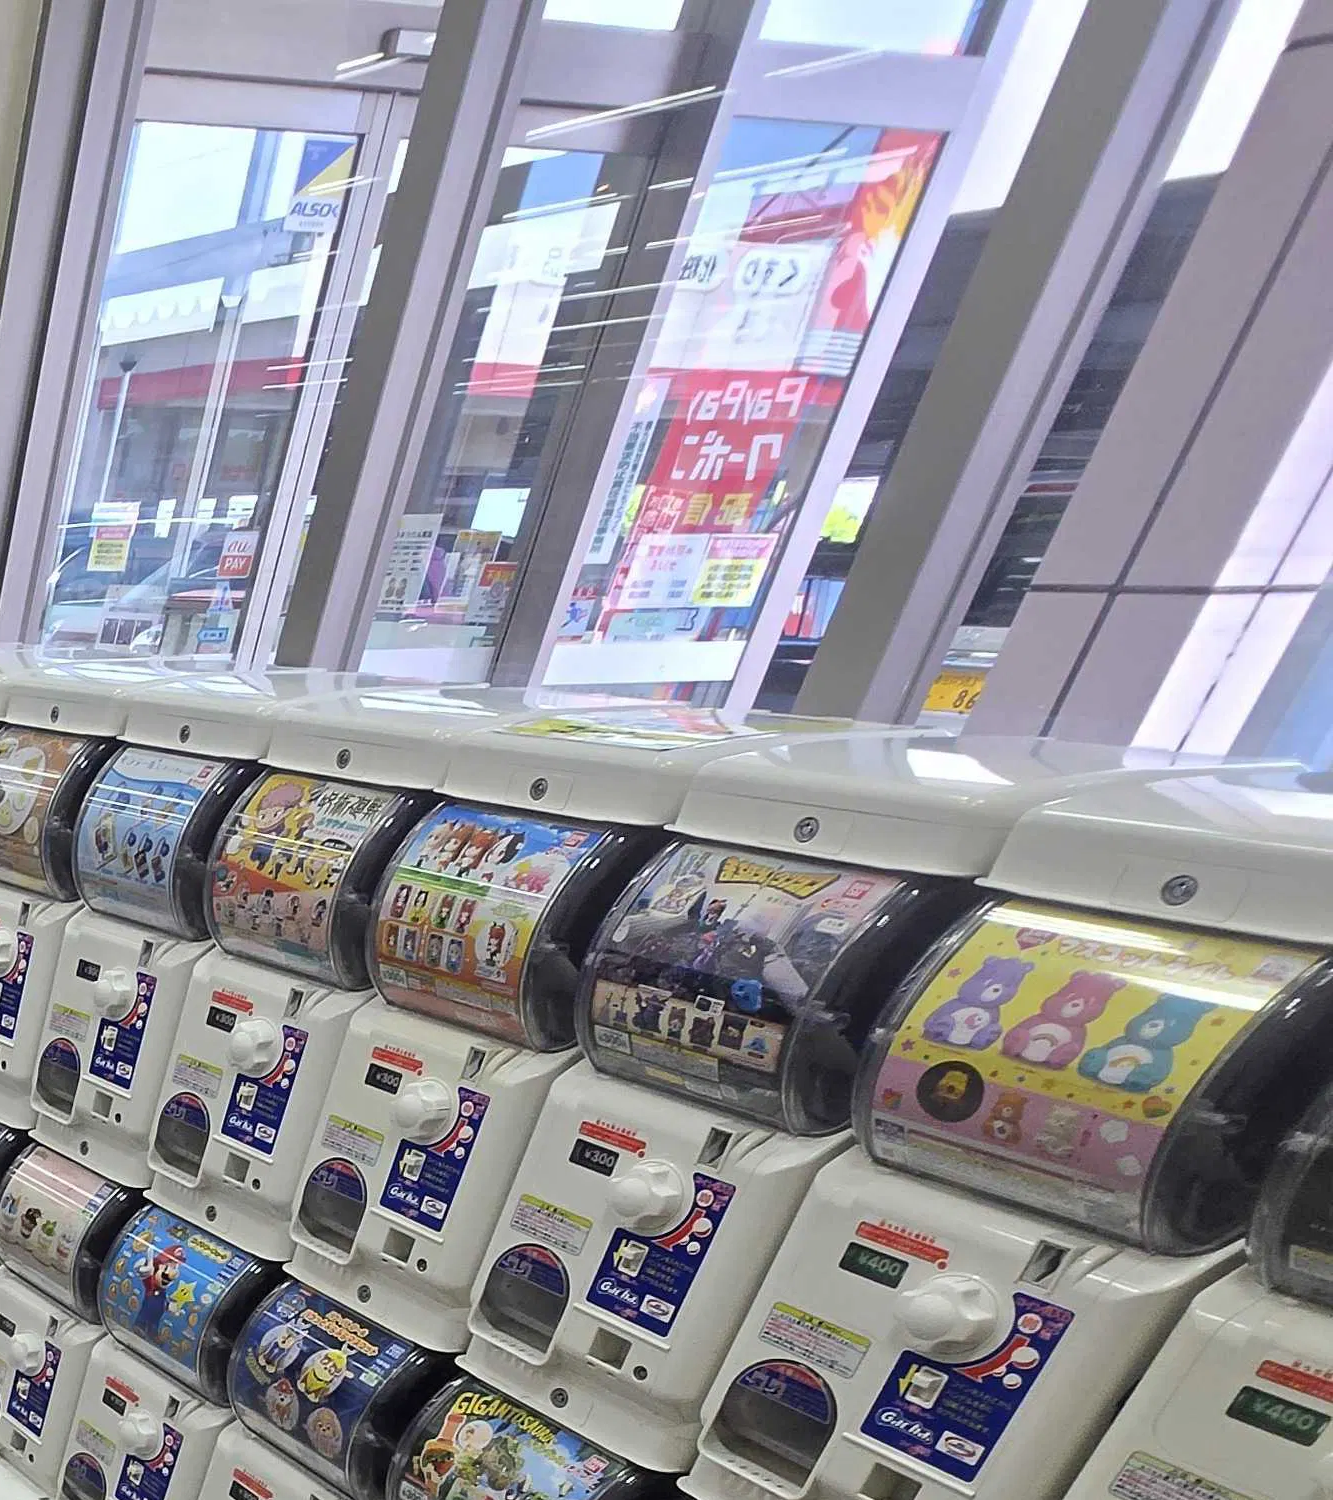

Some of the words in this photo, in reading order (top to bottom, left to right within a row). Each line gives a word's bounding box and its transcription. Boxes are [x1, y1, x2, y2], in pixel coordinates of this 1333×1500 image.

[223, 557, 247, 571] PAY
[375, 1072, 400, 1088] ¥300
[584, 1147, 616, 1169] ¥300
[857, 1249, 902, 1277] ¥400
[453, 1391, 555, 1445] GIGANTOSAURUS
[1251, 1397, 1316, 1431] ¥400
